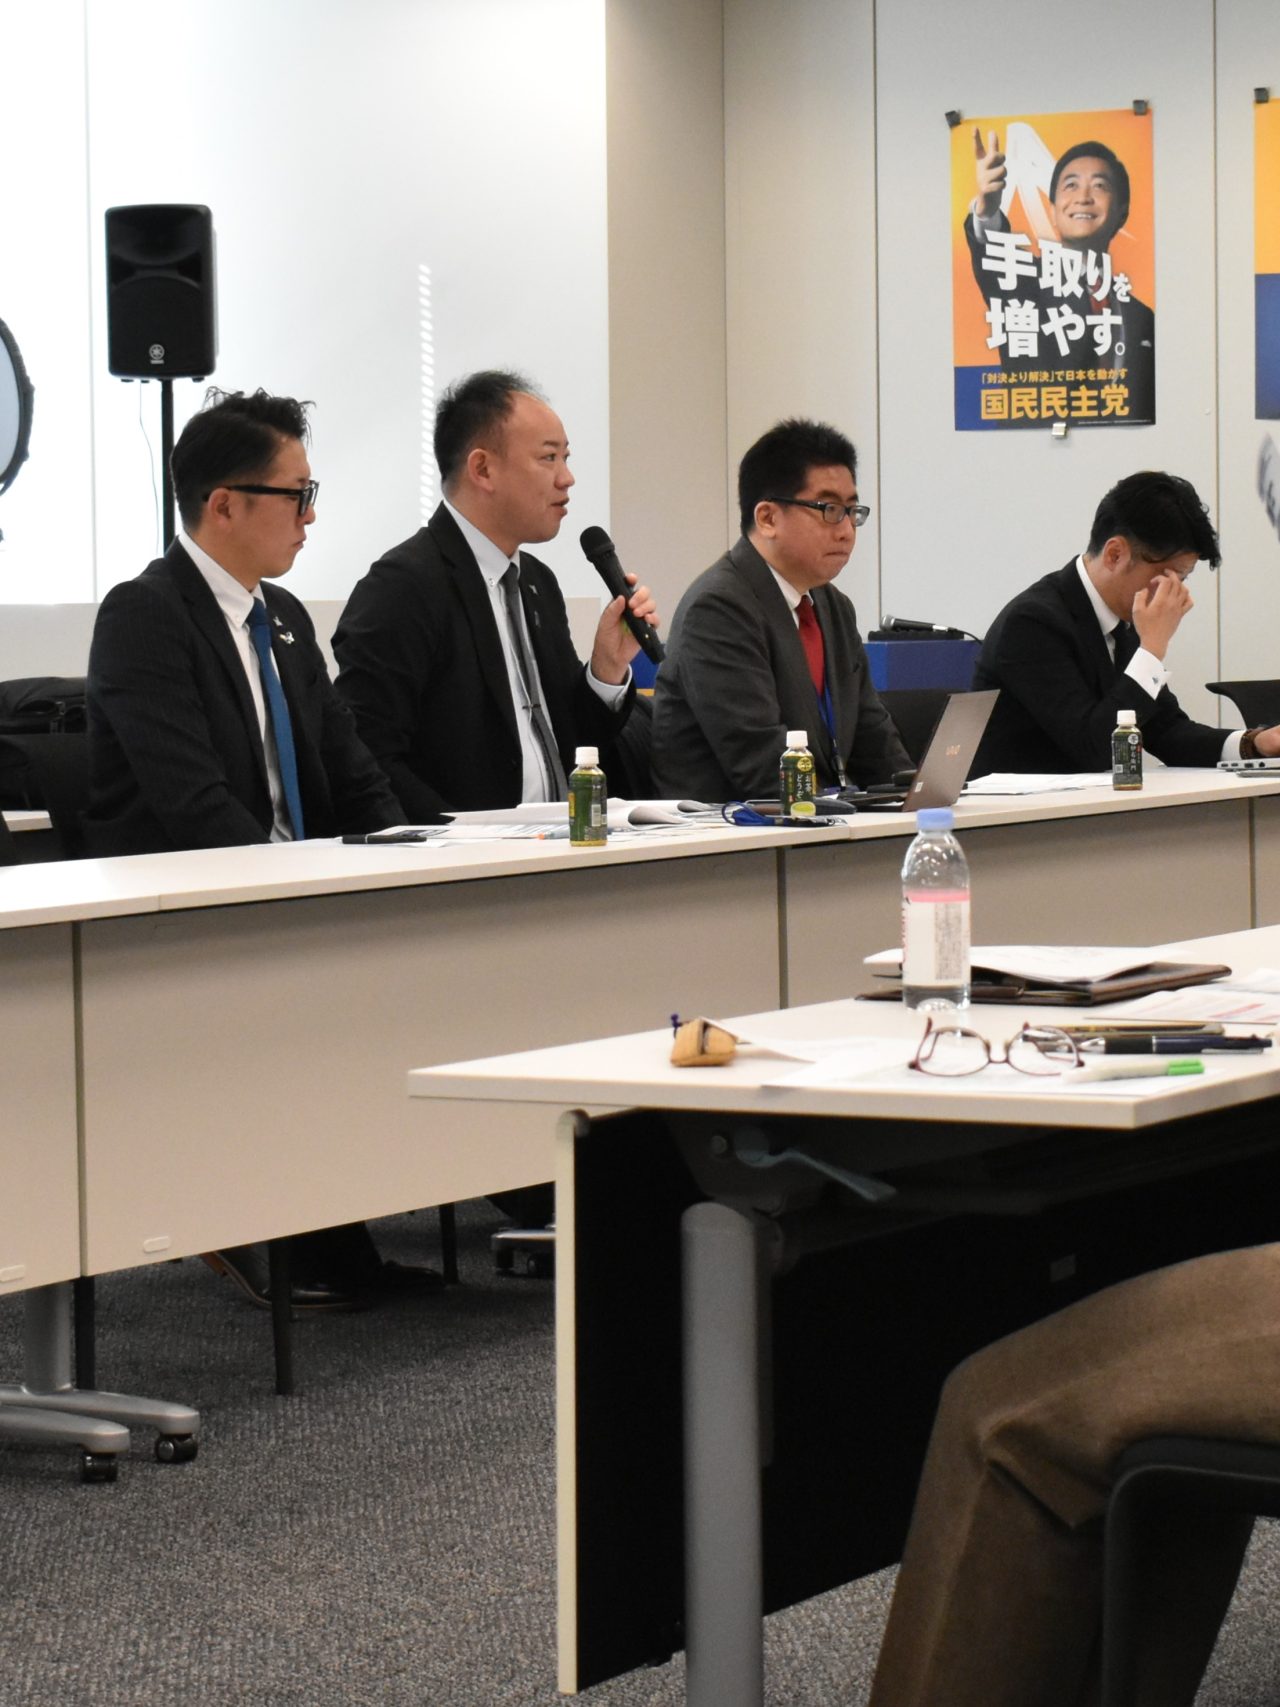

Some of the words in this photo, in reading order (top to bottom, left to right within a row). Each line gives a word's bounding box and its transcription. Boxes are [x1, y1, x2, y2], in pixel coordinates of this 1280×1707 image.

[982, 229, 1132, 303] 手取りを
[986, 297, 1126, 358] 増やす。
[980, 384, 1130, 420] 国民民主党
